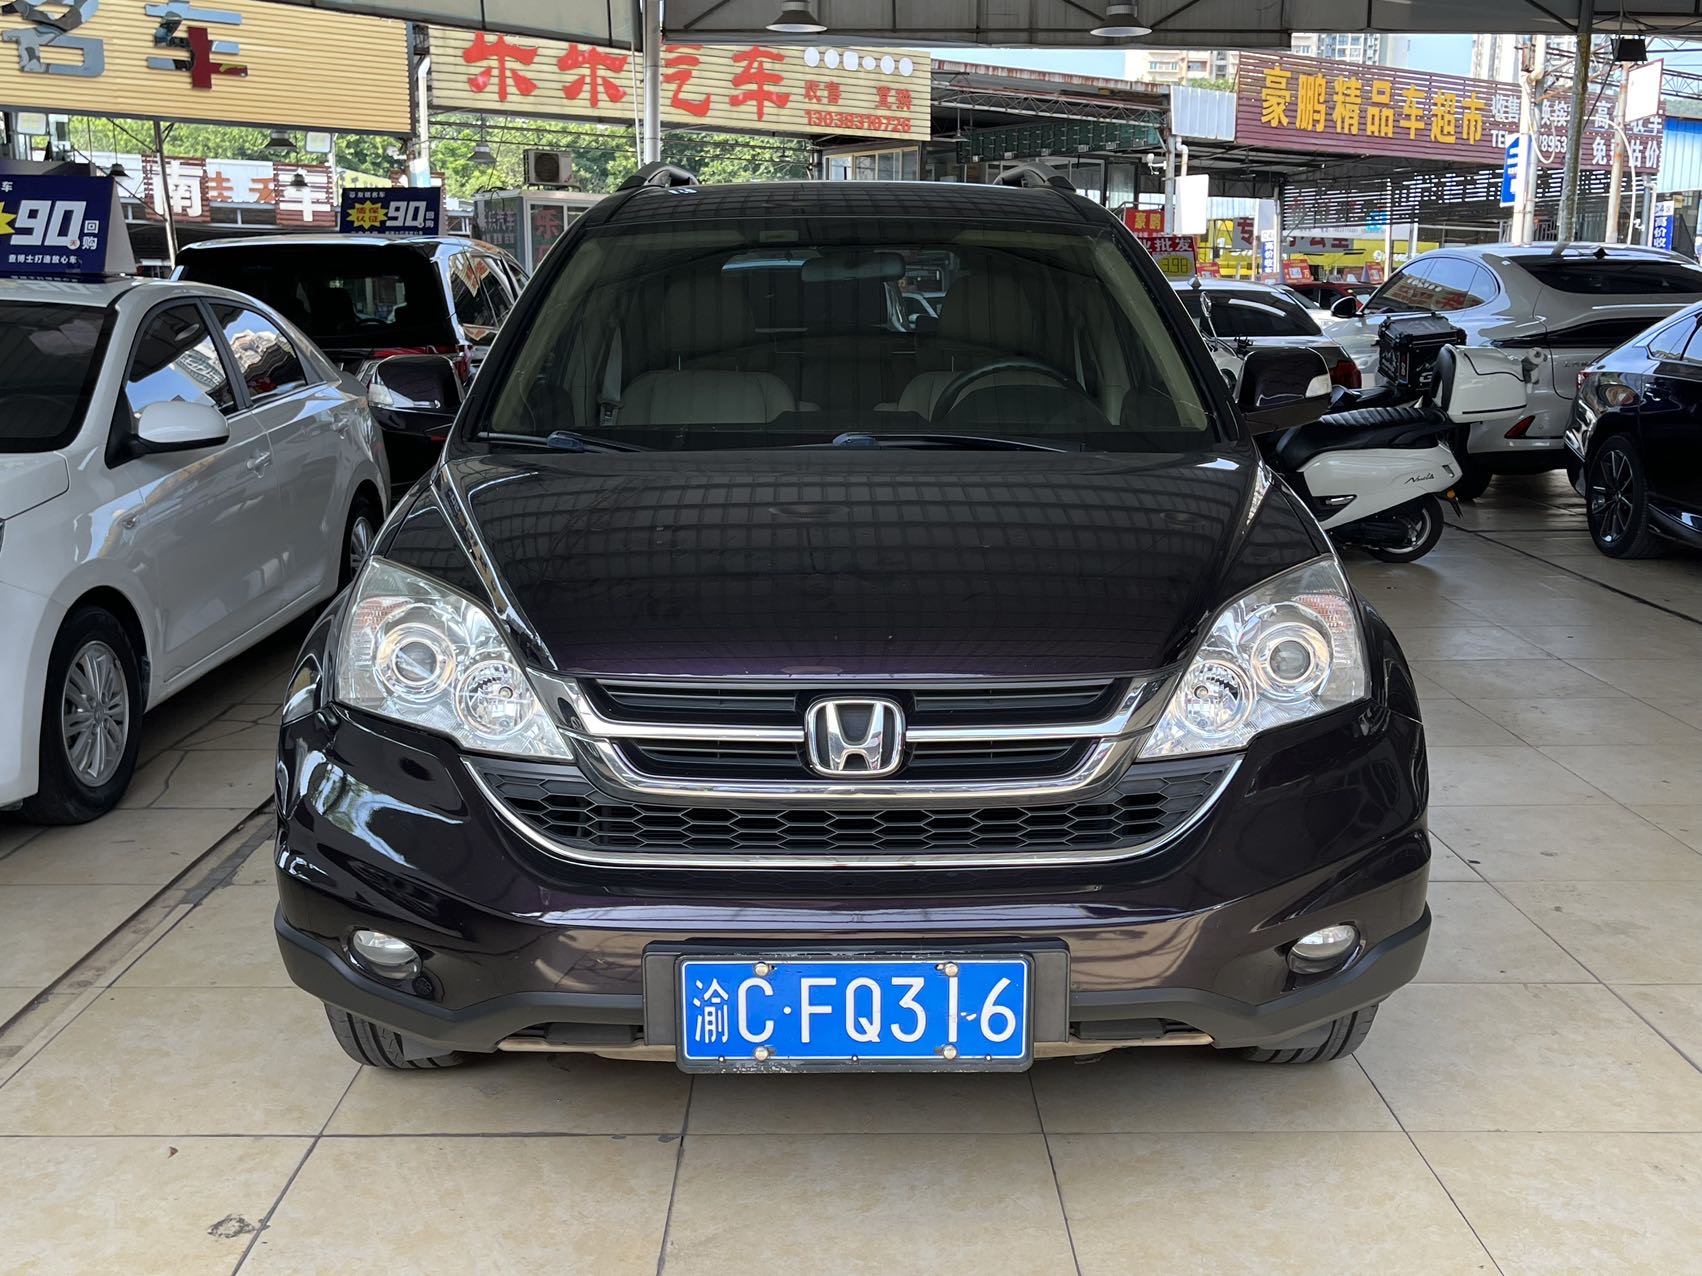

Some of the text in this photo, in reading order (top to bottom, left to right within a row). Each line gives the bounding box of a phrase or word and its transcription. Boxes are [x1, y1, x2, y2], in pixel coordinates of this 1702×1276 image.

[1260, 63, 1486, 145] 豪鹏精品车超市
[1592, 136, 1660, 168] 免估价
[10, 200, 87, 246] 90
[385, 201, 427, 227] 90
[693, 976, 1017, 1045] 渝C·FQ316
